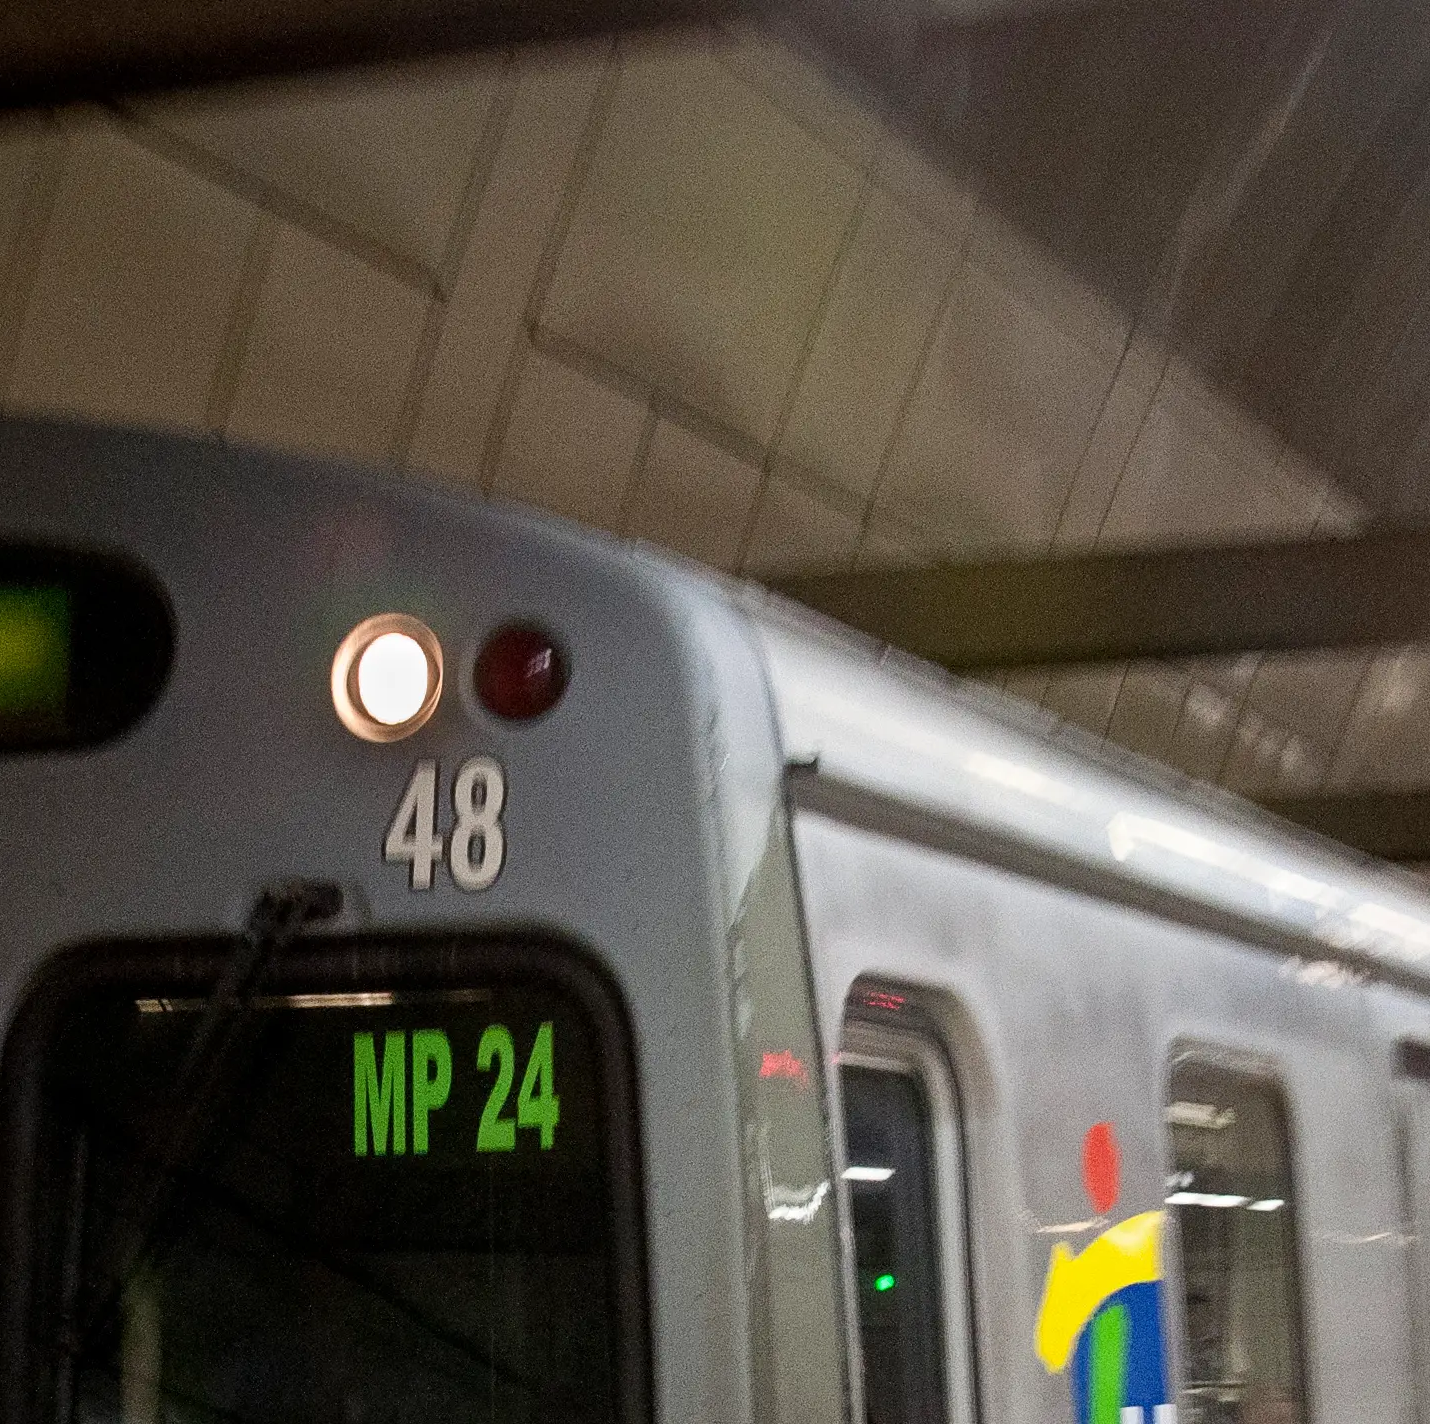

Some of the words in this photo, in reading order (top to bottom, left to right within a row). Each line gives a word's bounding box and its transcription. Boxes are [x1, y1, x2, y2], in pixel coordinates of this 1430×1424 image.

[383, 755, 508, 892] 48
[353, 1028, 453, 1157] MP
[475, 1020, 561, 1152] 24
